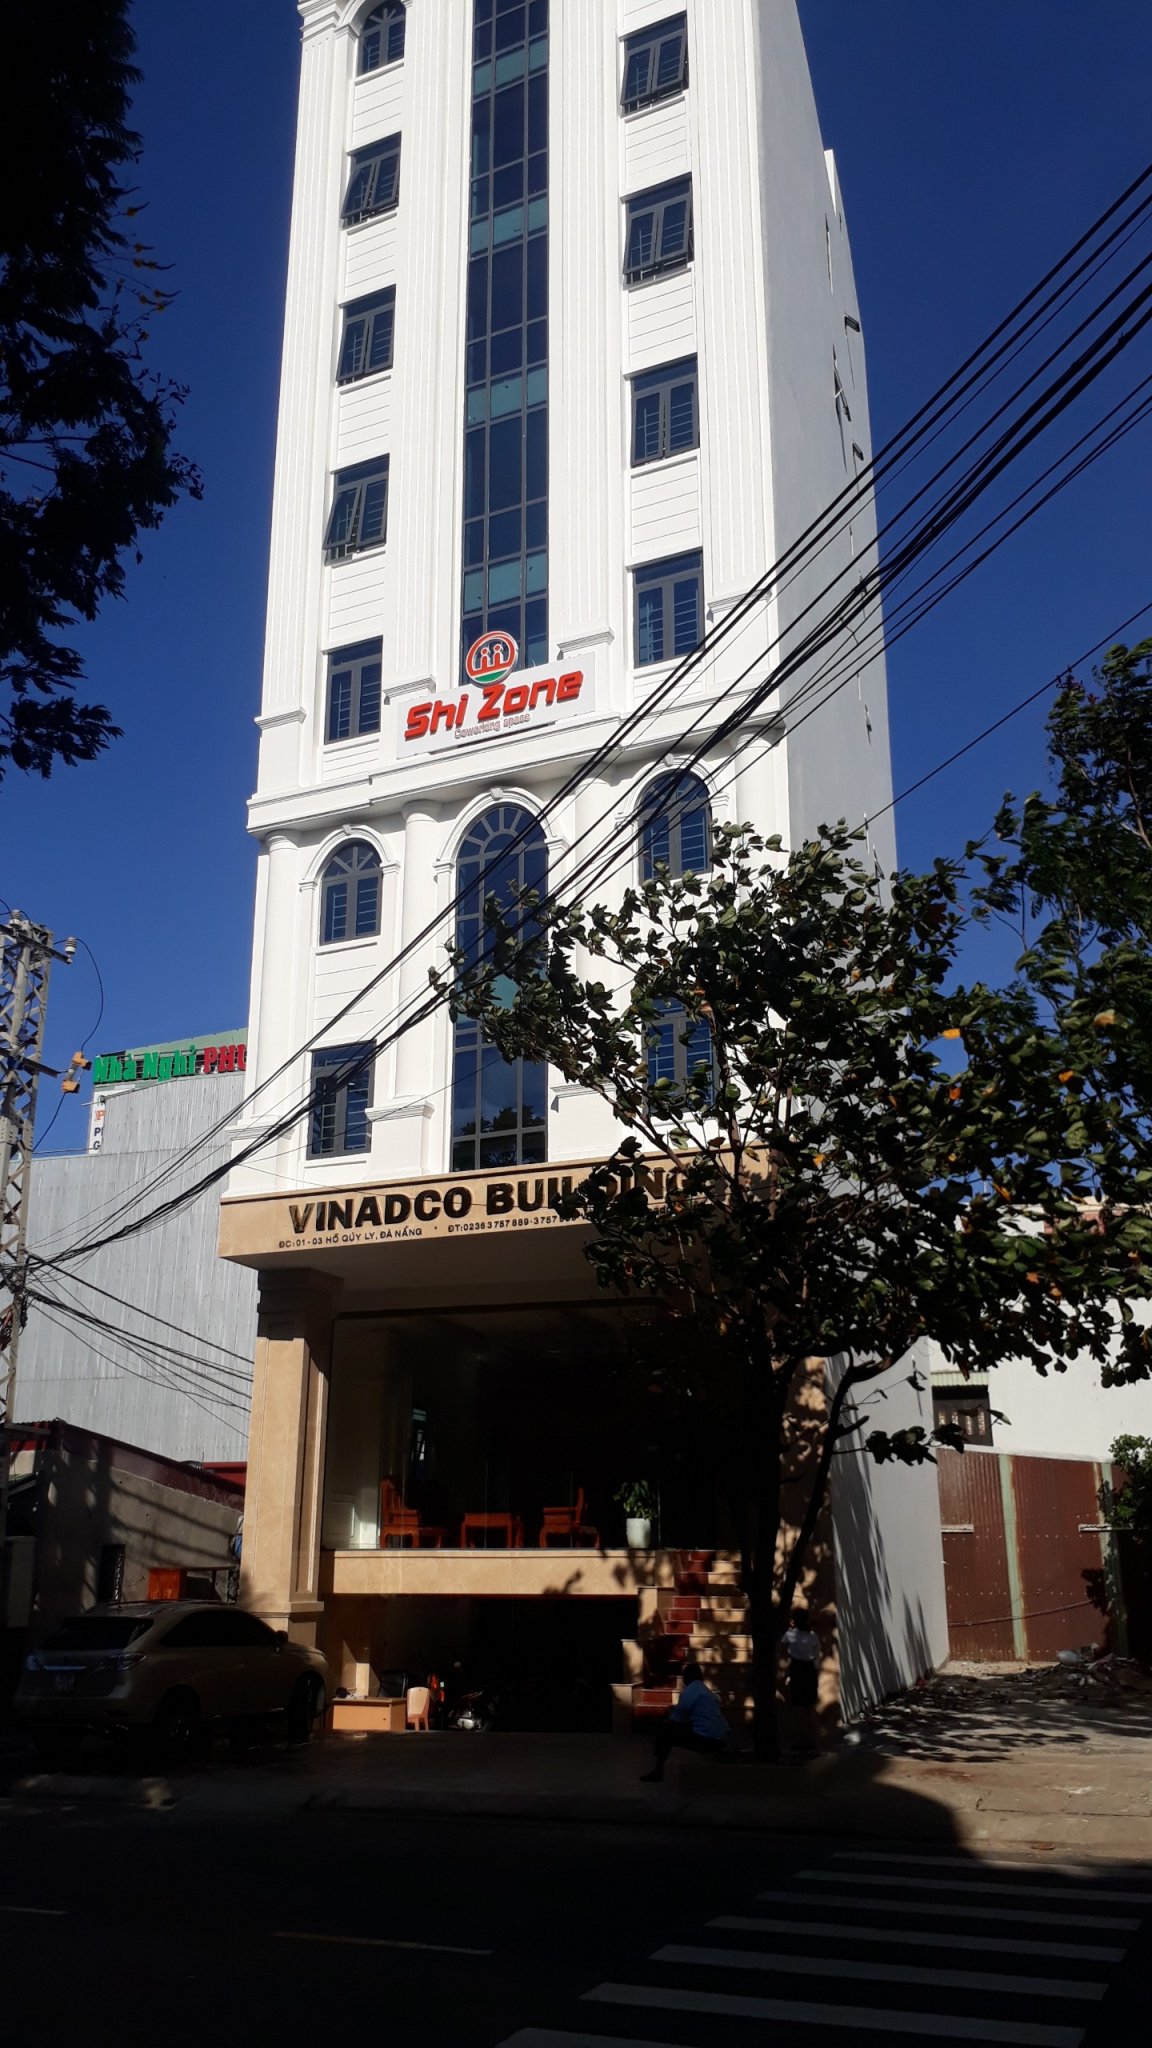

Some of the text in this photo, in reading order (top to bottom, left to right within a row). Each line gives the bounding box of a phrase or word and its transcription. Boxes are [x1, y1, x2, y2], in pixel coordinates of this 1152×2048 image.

[404, 669, 584, 741] Shi Zone
[455, 713, 531, 739] Coworking space
[94, 1053, 137, 1084] Nhà
[142, 1044, 197, 1083] Nghỉ
[288, 1186, 473, 1234] VINADCO
